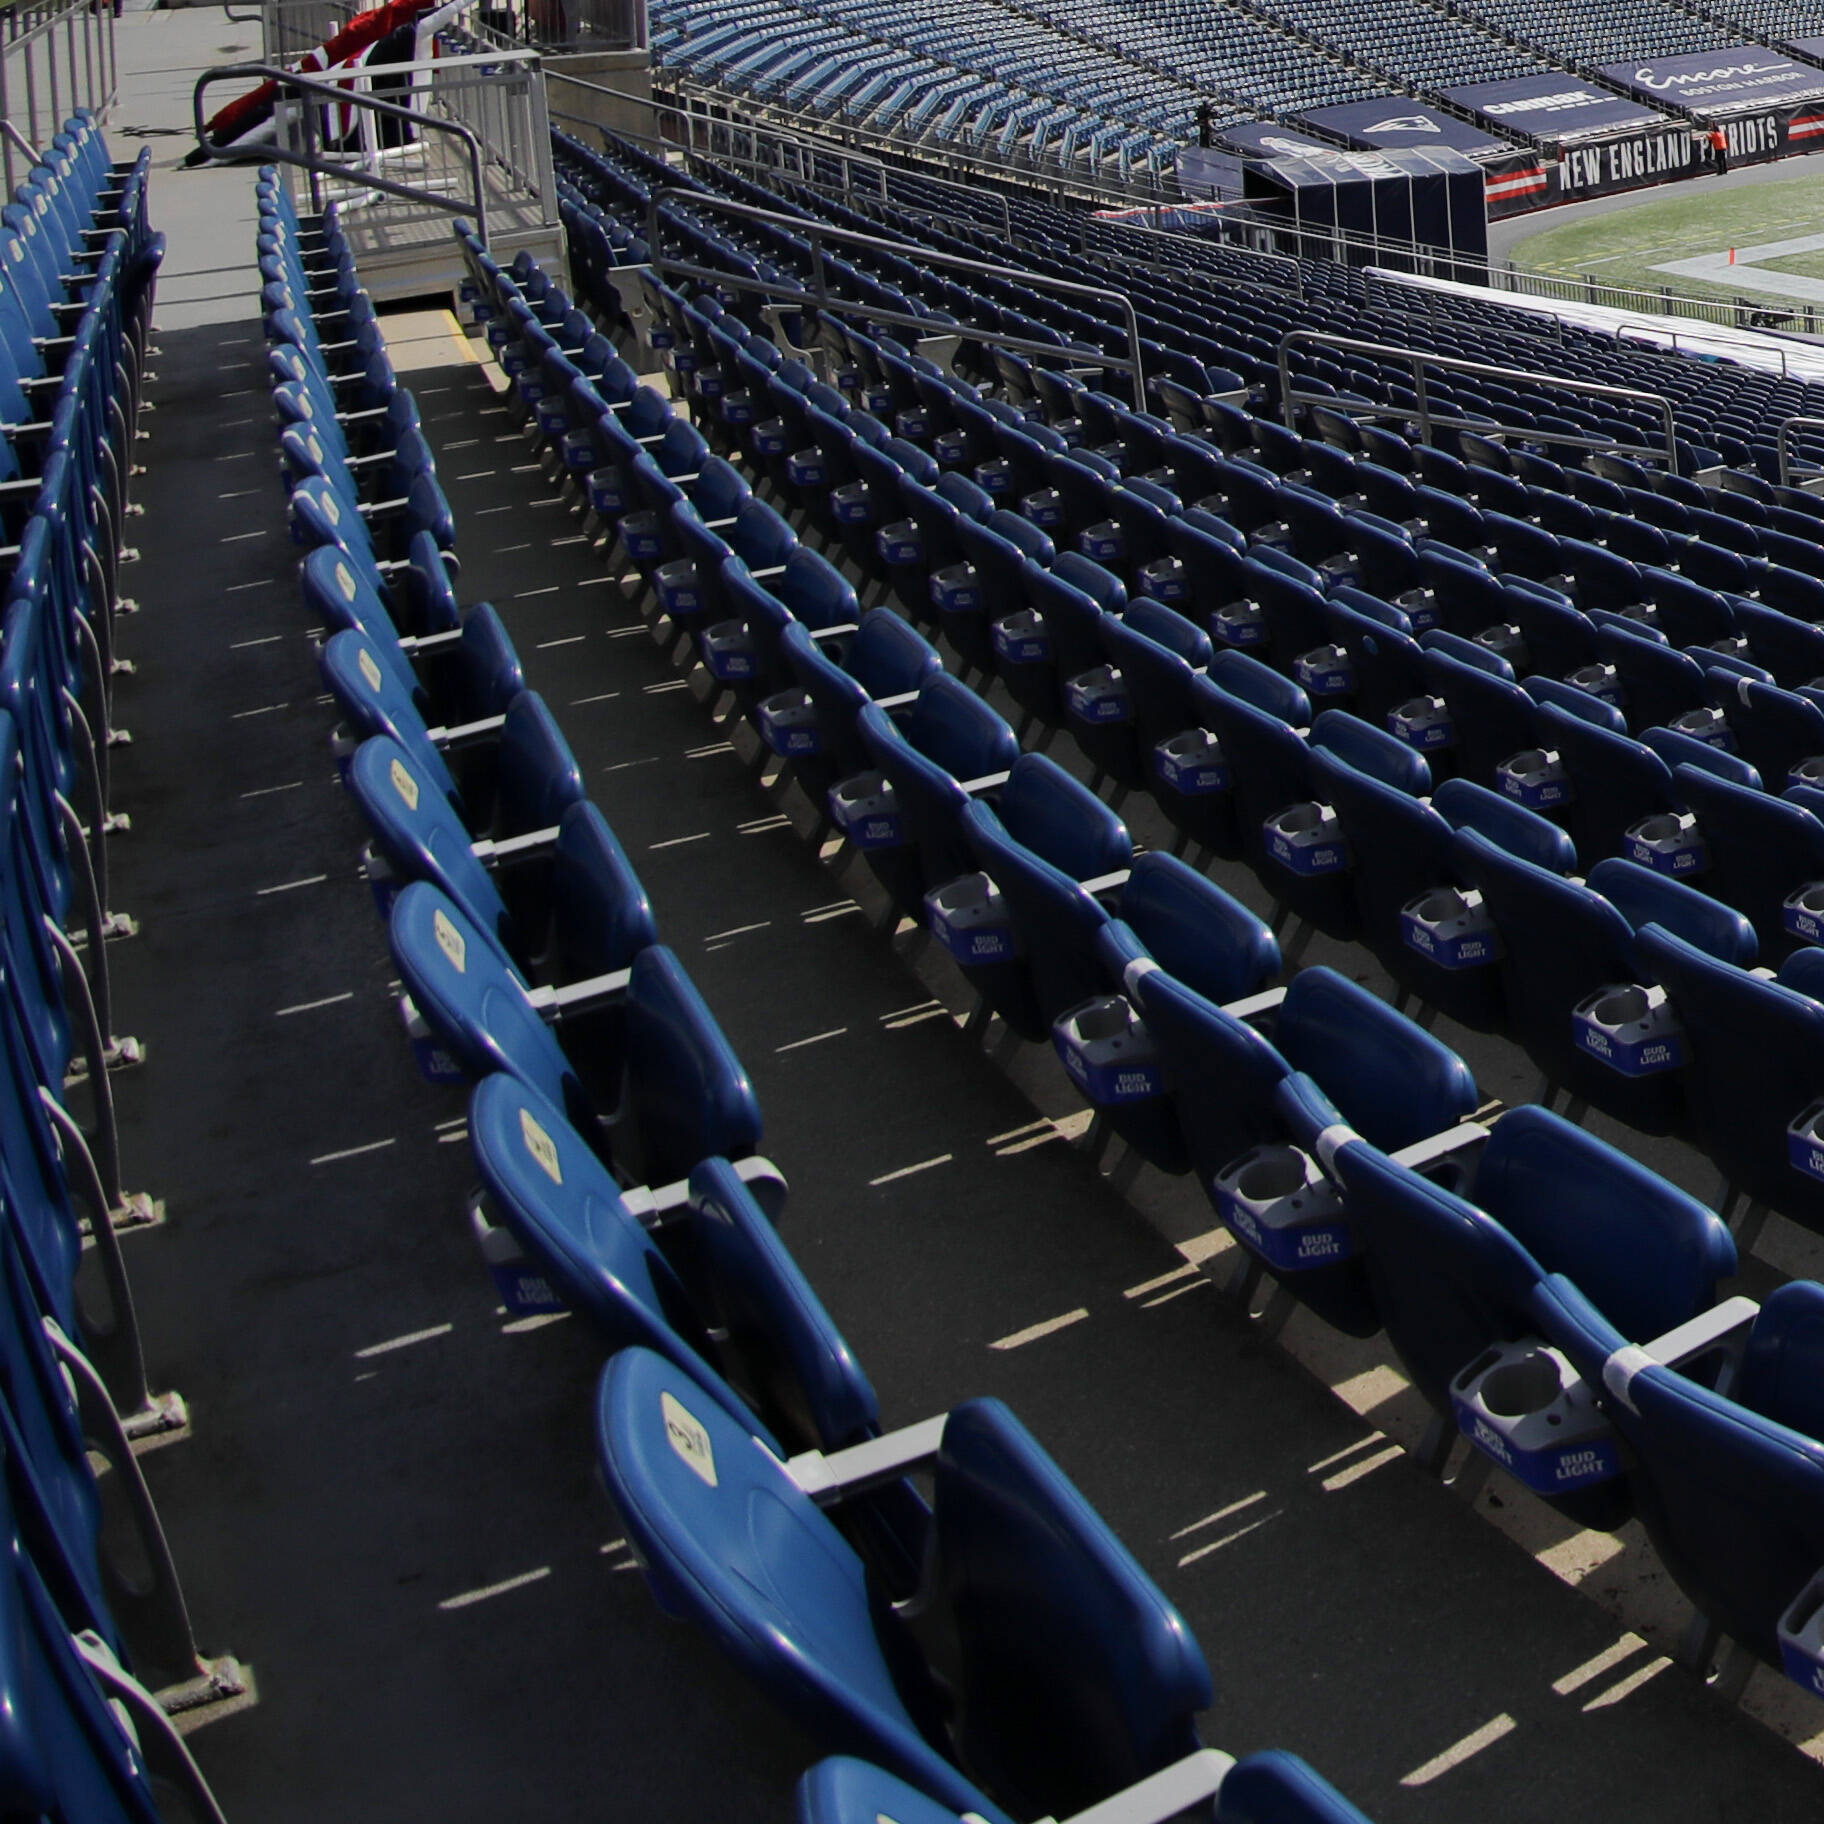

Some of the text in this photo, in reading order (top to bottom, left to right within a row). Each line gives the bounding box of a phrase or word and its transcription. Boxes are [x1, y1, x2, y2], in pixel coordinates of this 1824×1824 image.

[1634, 61, 1793, 90] Encore
[1679, 70, 1807, 98] BOSTON HARBOR
[1559, 116, 1778, 191] NEW ENGLAND PTRIOTS
[1311, 855, 1339, 867] LIGHT
[1457, 948, 1487, 961] LIGHT
[1460, 942, 1482, 954] BUD
[1644, 1045, 1667, 1058] BUD
[1640, 1052, 1671, 1066] LIGHT
[1302, 1233, 1333, 1247] BUD
[1298, 1243, 1340, 1257] LIGHT
[1560, 1450, 1596, 1469] BUD
[1556, 1459, 1605, 1480] LIGHT
